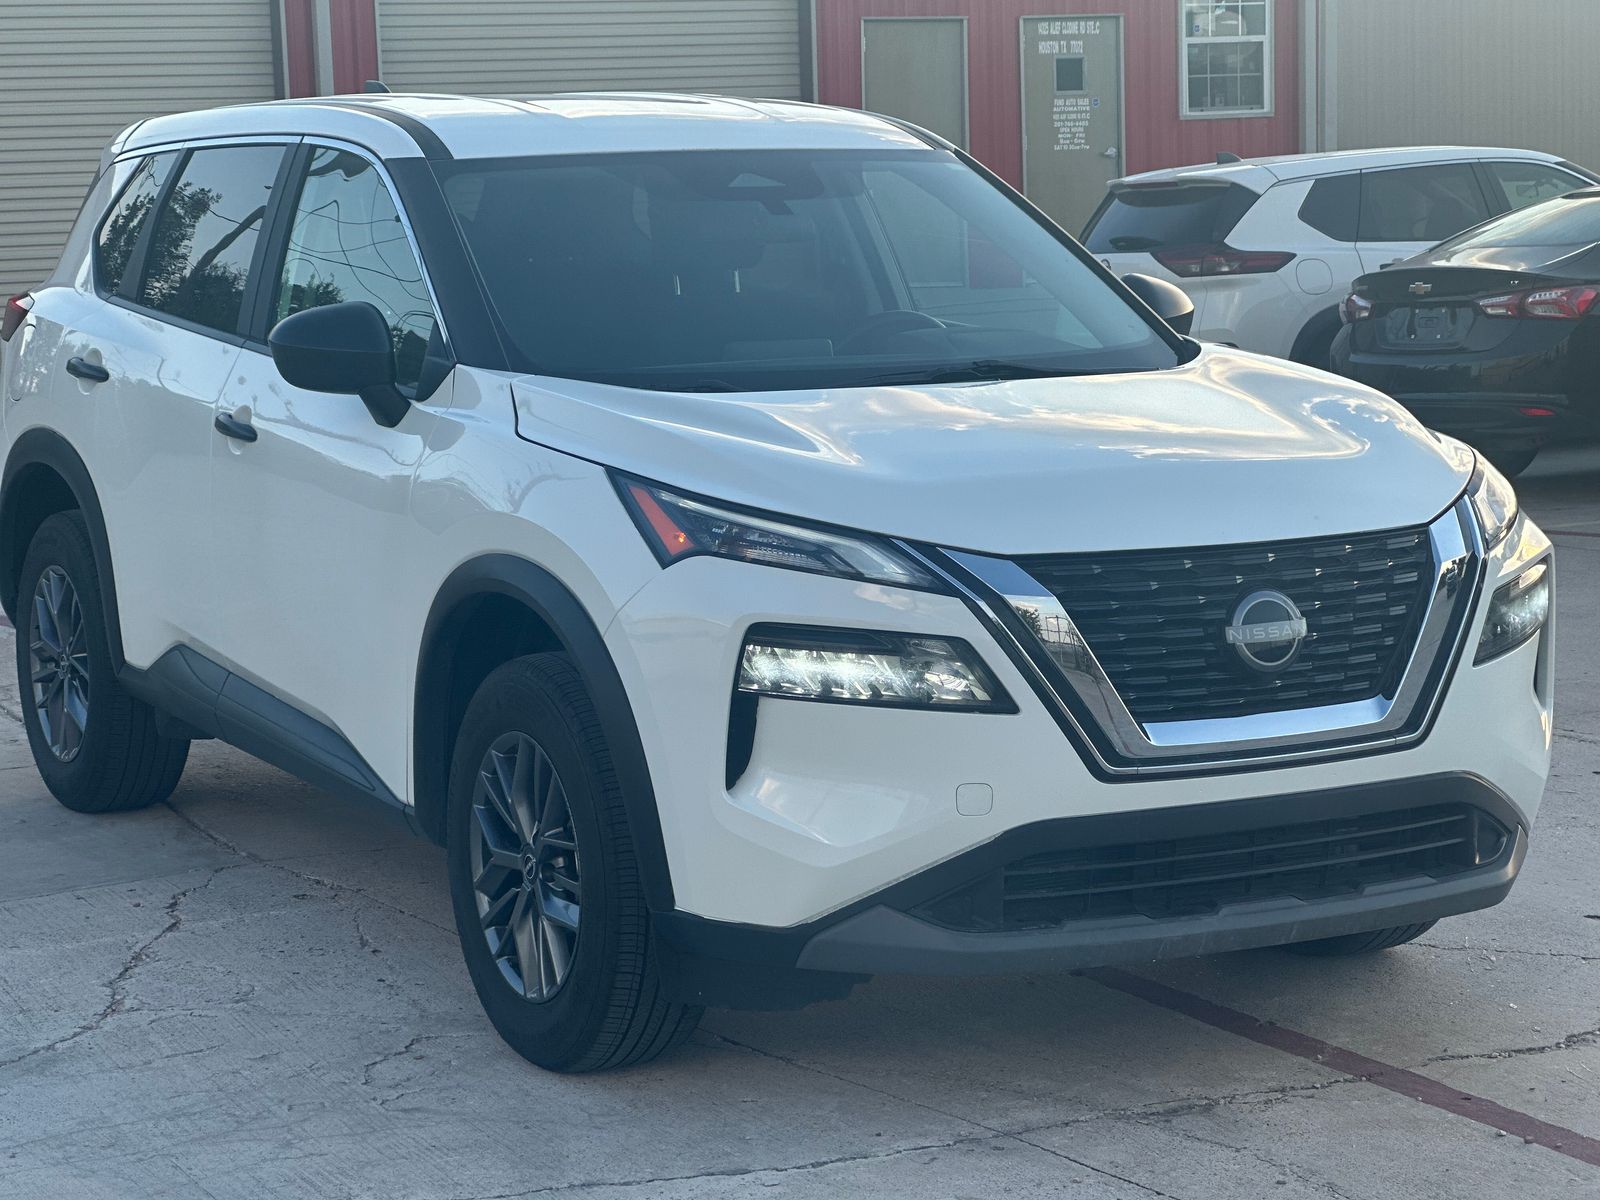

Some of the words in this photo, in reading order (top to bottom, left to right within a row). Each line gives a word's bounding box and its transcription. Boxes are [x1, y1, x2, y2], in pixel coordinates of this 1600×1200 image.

[1038, 40, 1059, 54] HOUSTON
[1060, 40, 1067, 54] TX
[1228, 622, 1306, 641] NISSAN
